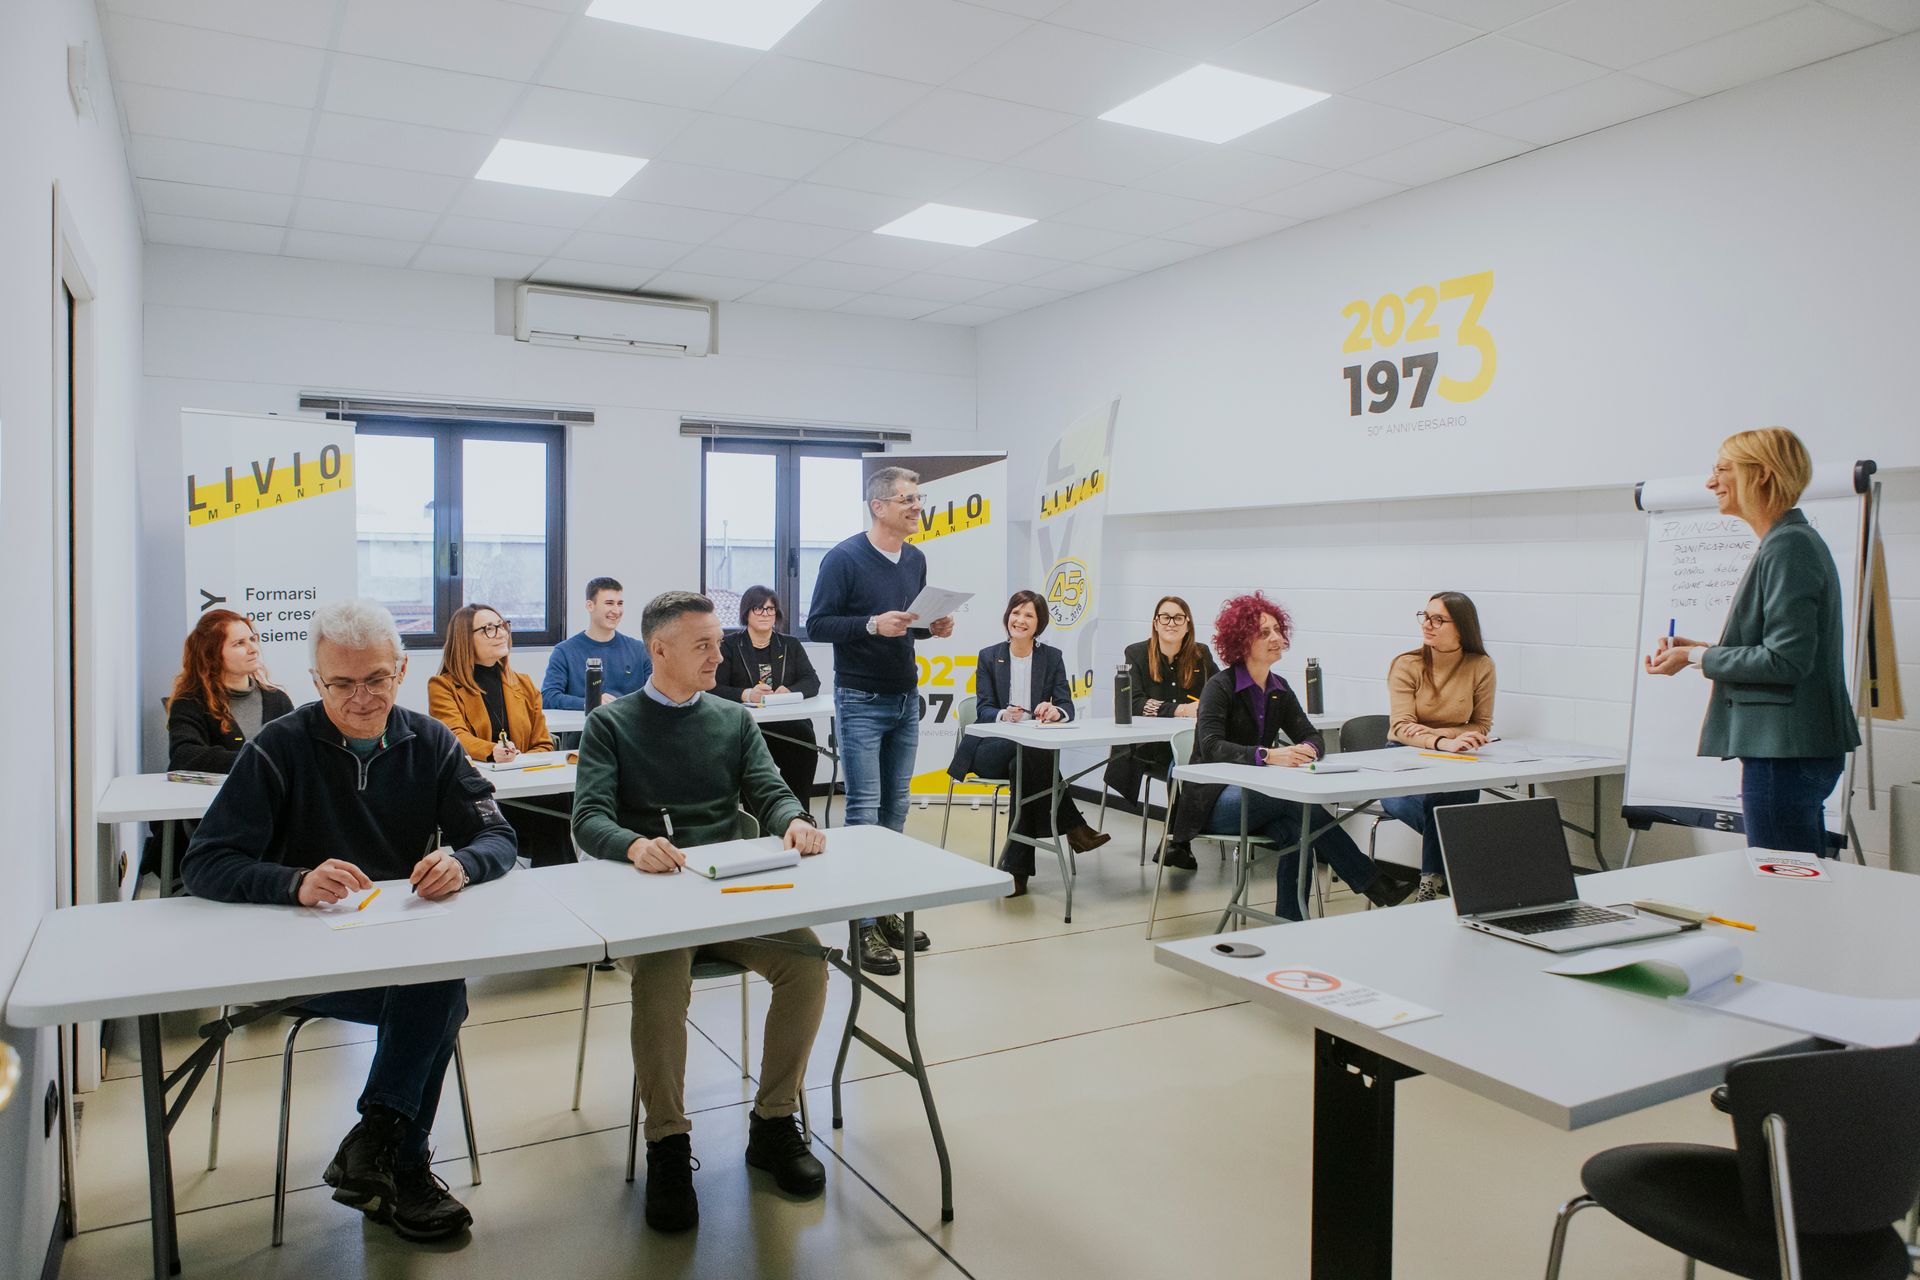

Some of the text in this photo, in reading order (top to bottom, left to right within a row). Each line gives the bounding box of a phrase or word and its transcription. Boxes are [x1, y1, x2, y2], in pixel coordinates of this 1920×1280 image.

[1386, 415, 1467, 435] ANNIVERSARIO
[187, 444, 341, 512] LIVIO
[1040, 469, 1100, 513] LIVIO
[189, 479, 342, 525] IMPIANTI
[921, 493, 983, 532] VIO
[908, 517, 983, 544] PIANTI
[246, 587, 316, 601] Formarsi
[247, 610, 273, 622] per
